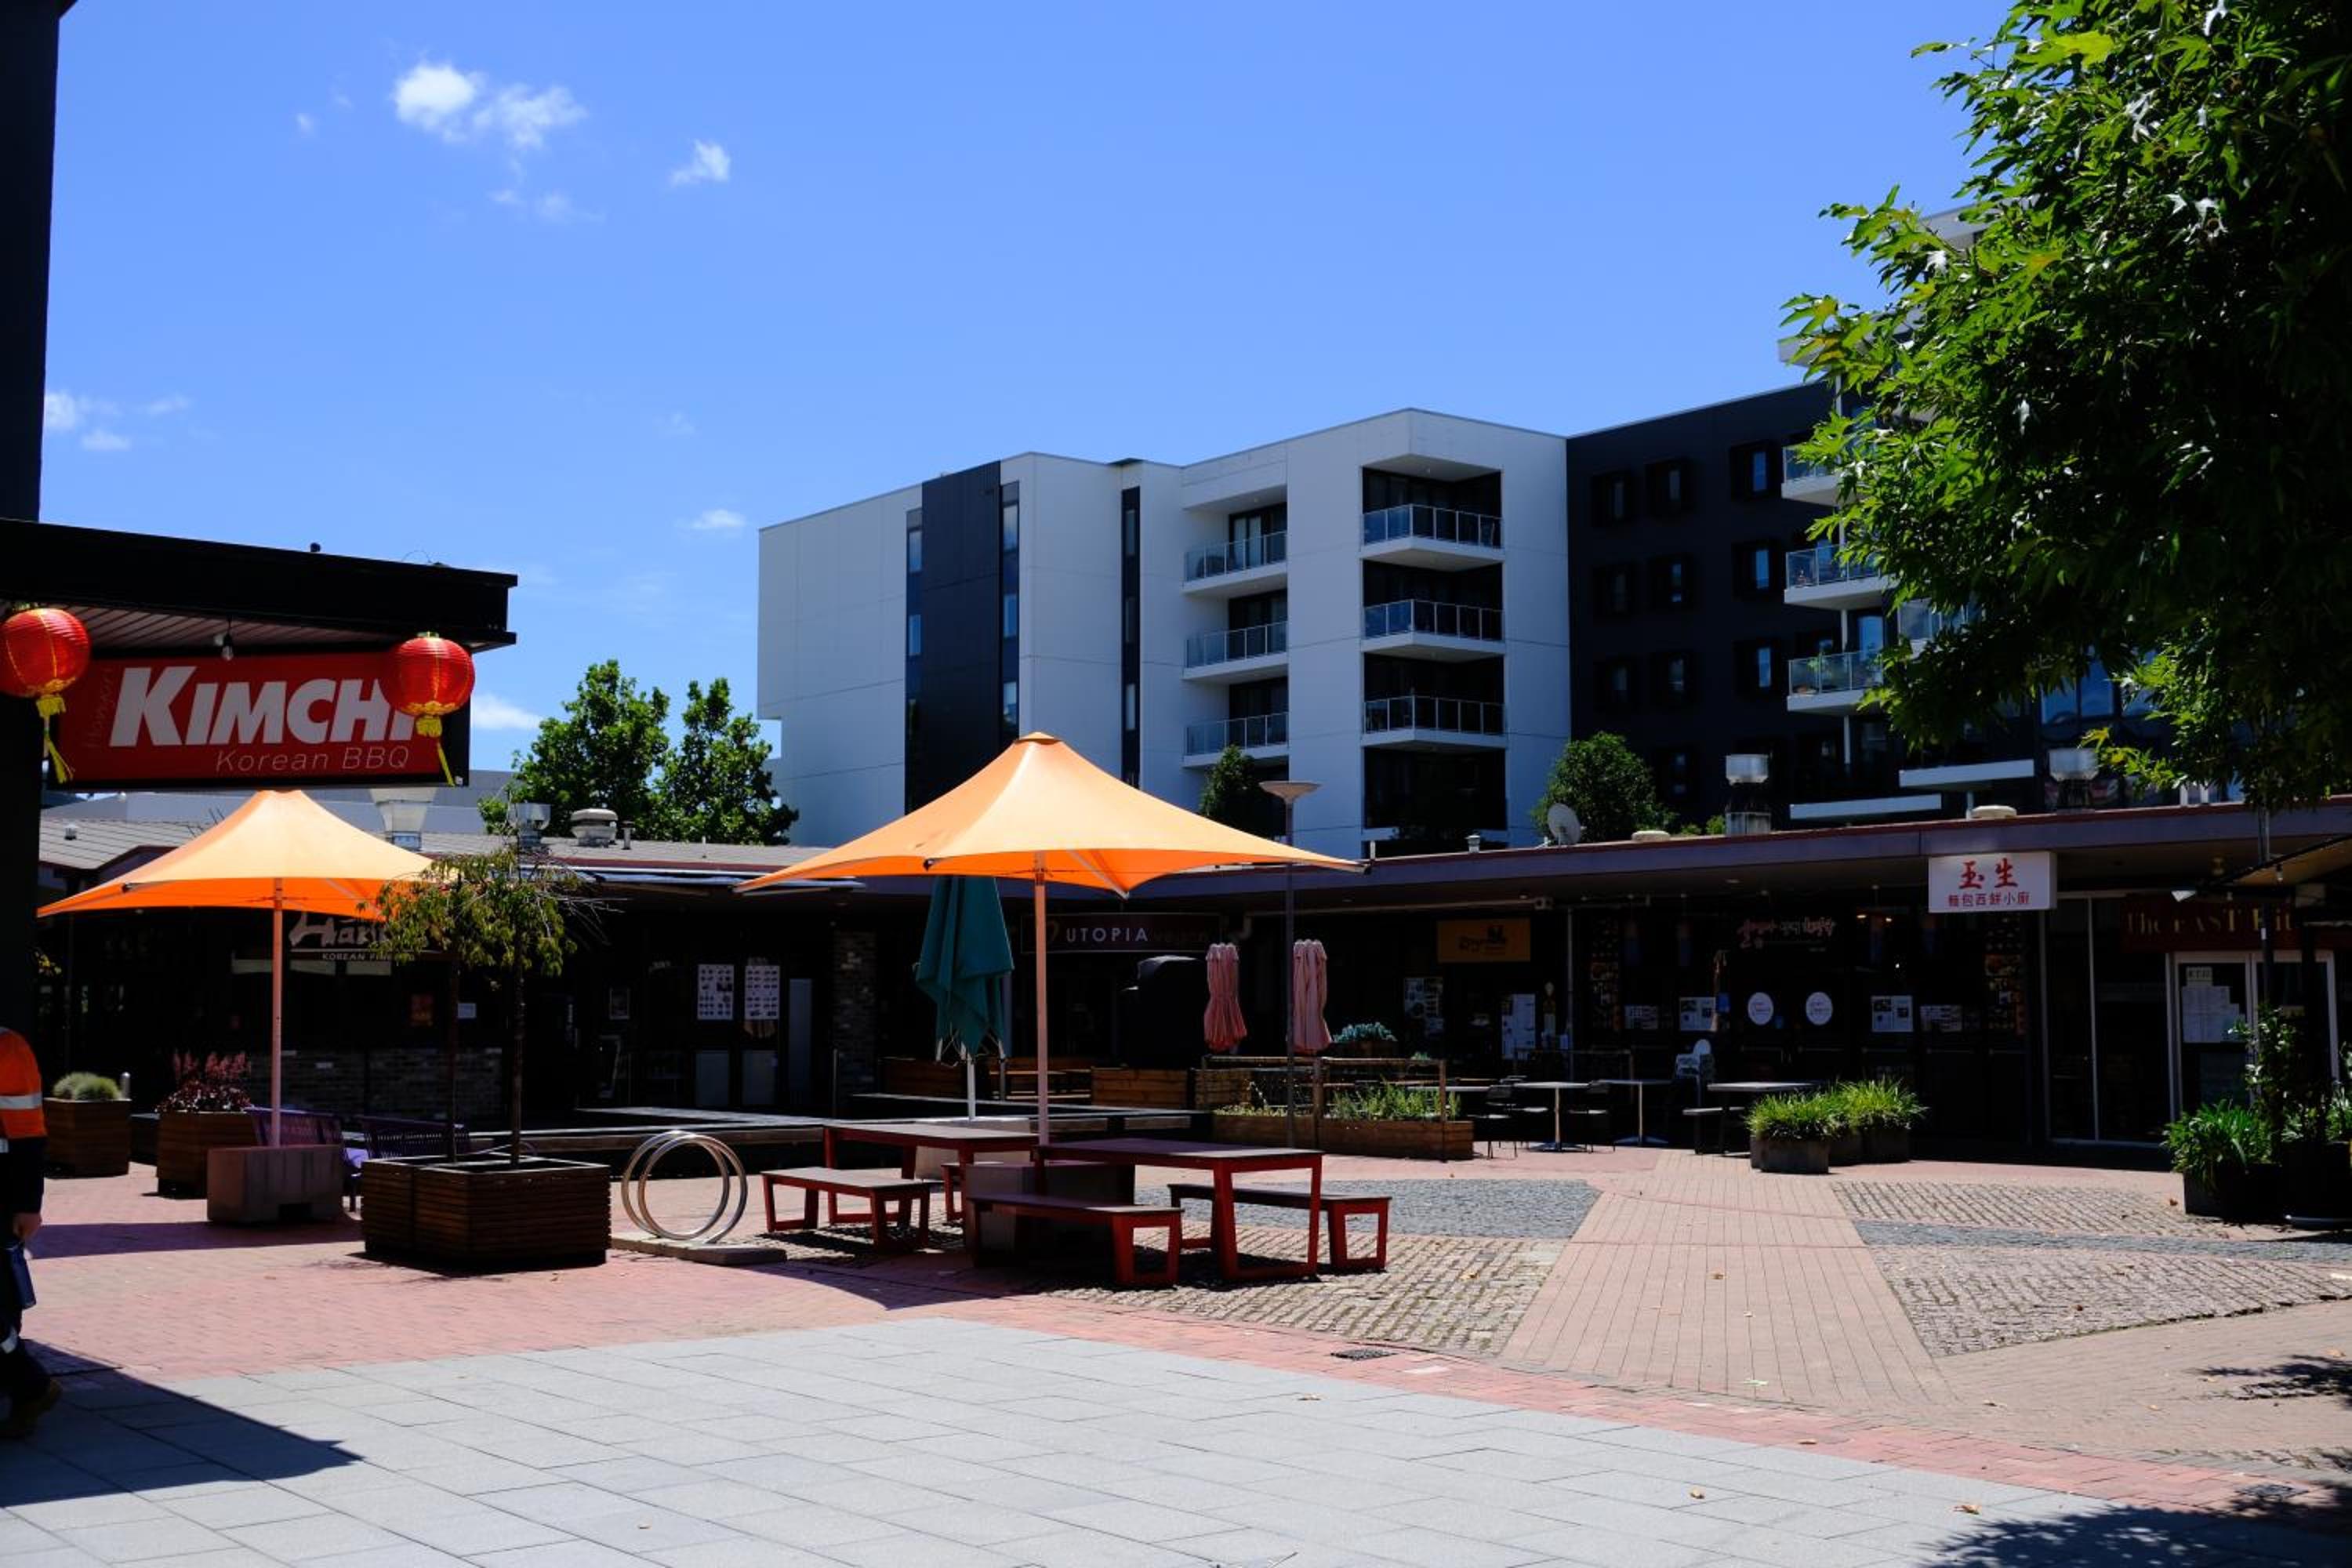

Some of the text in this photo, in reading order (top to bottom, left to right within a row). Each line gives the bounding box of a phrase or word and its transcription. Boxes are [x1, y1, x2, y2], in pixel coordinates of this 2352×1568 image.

[215, 745, 410, 773] Korean BBQ
[1065, 927, 1149, 942] UTOPIA
[321, 952, 365, 961] KOREAN
